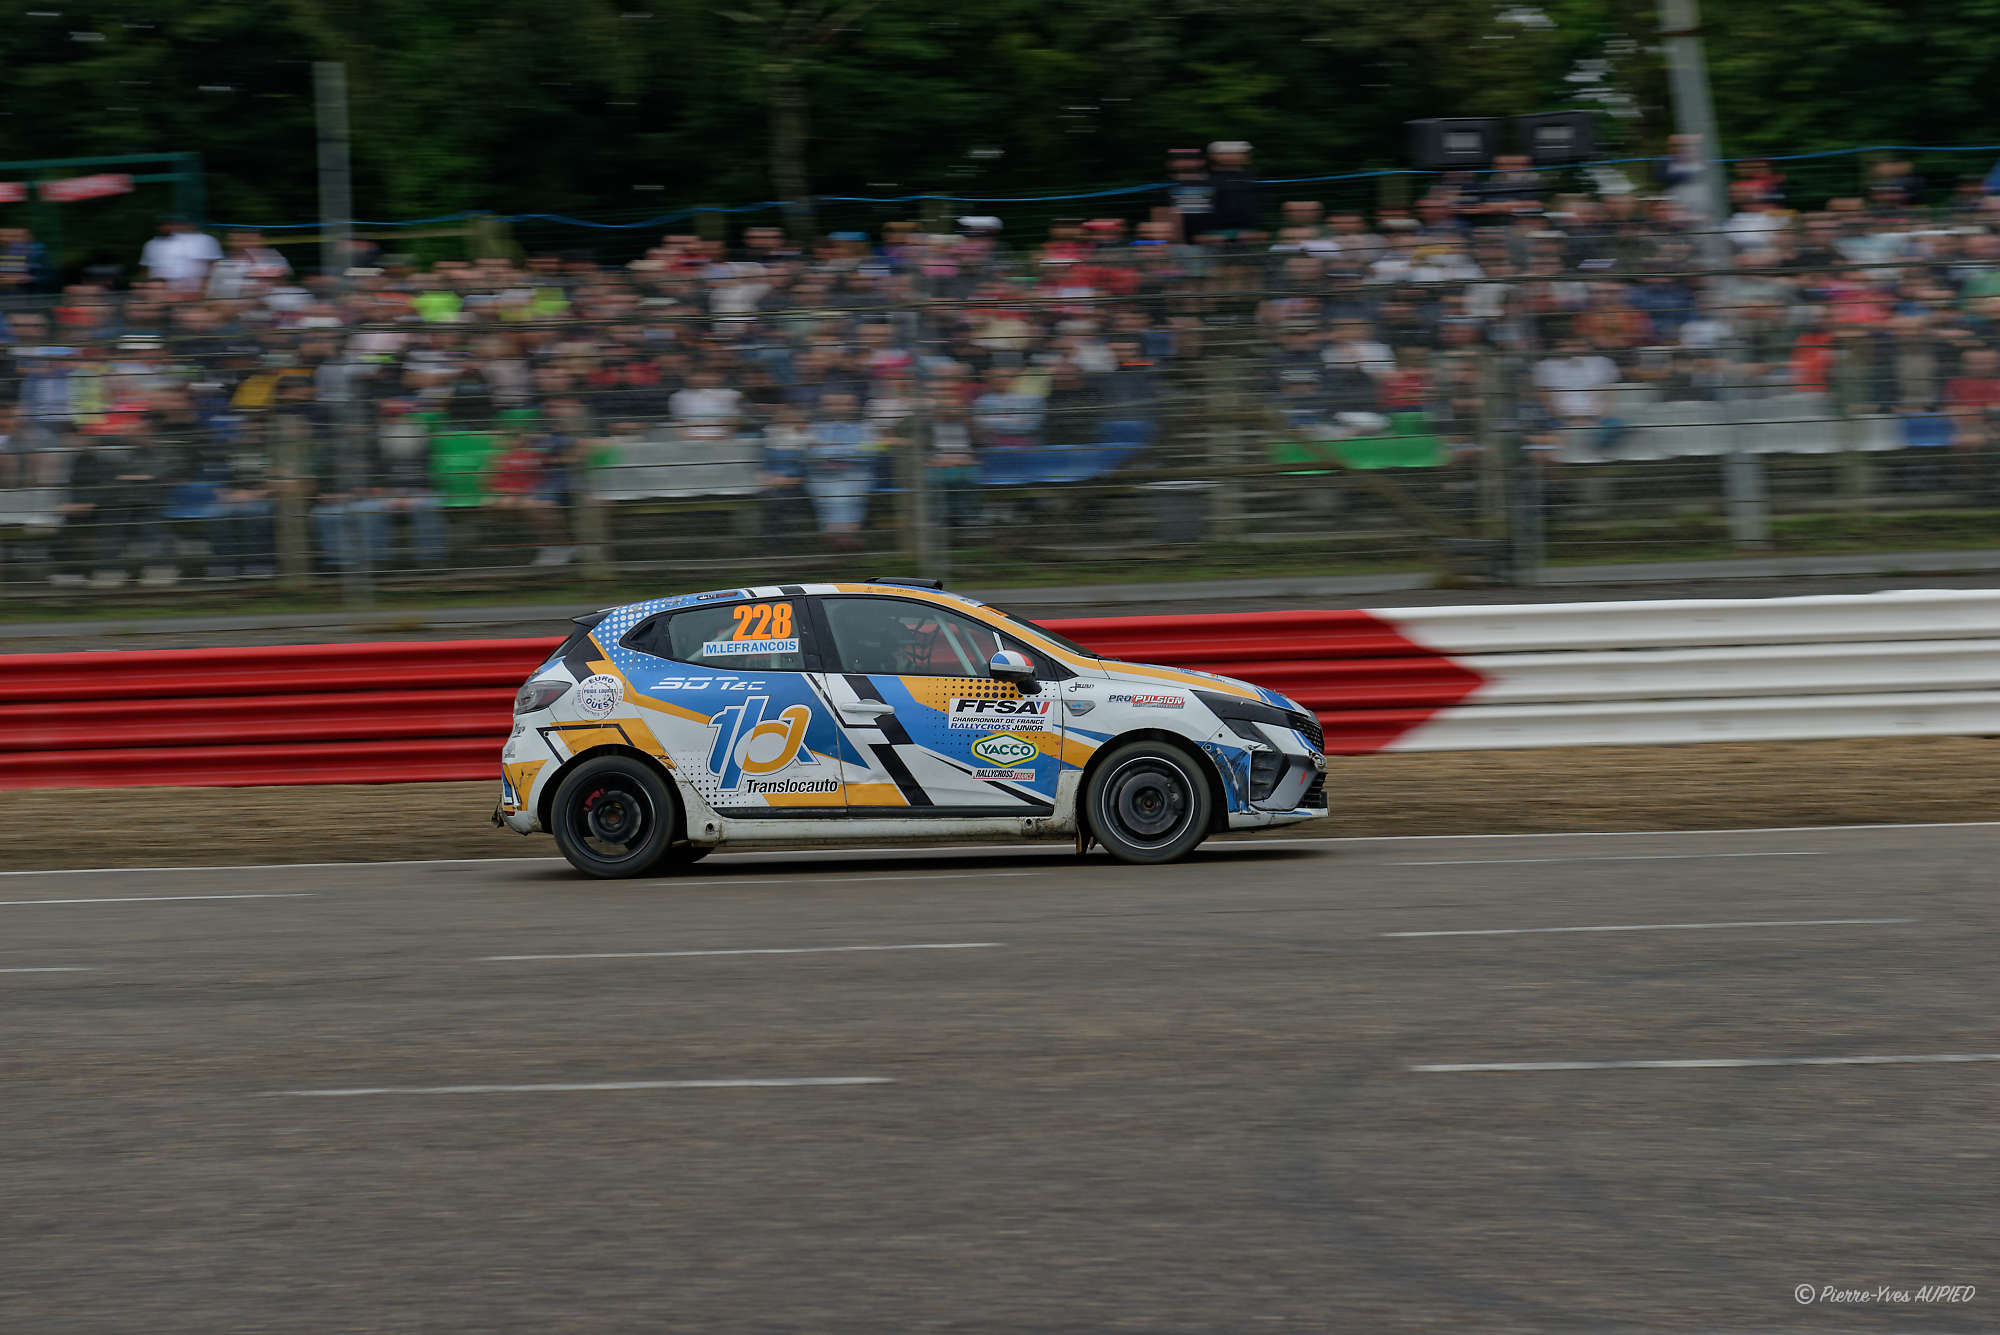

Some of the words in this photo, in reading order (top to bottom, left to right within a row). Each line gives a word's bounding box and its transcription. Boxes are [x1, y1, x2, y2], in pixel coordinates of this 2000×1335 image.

[732, 603, 793, 641] 228
[705, 641, 797, 655] M.LEFRANCOIS
[955, 699, 1039, 715] FFSA
[952, 716, 1004, 724] CHAMPIONNAT
[950, 722, 1011, 731] RALLYCROSS
[1011, 724, 1044, 732] JUNIOR
[981, 743, 1031, 756] YACCO
[975, 769, 1015, 778] RALLYCROSS
[746, 779, 838, 794] Translocauto
